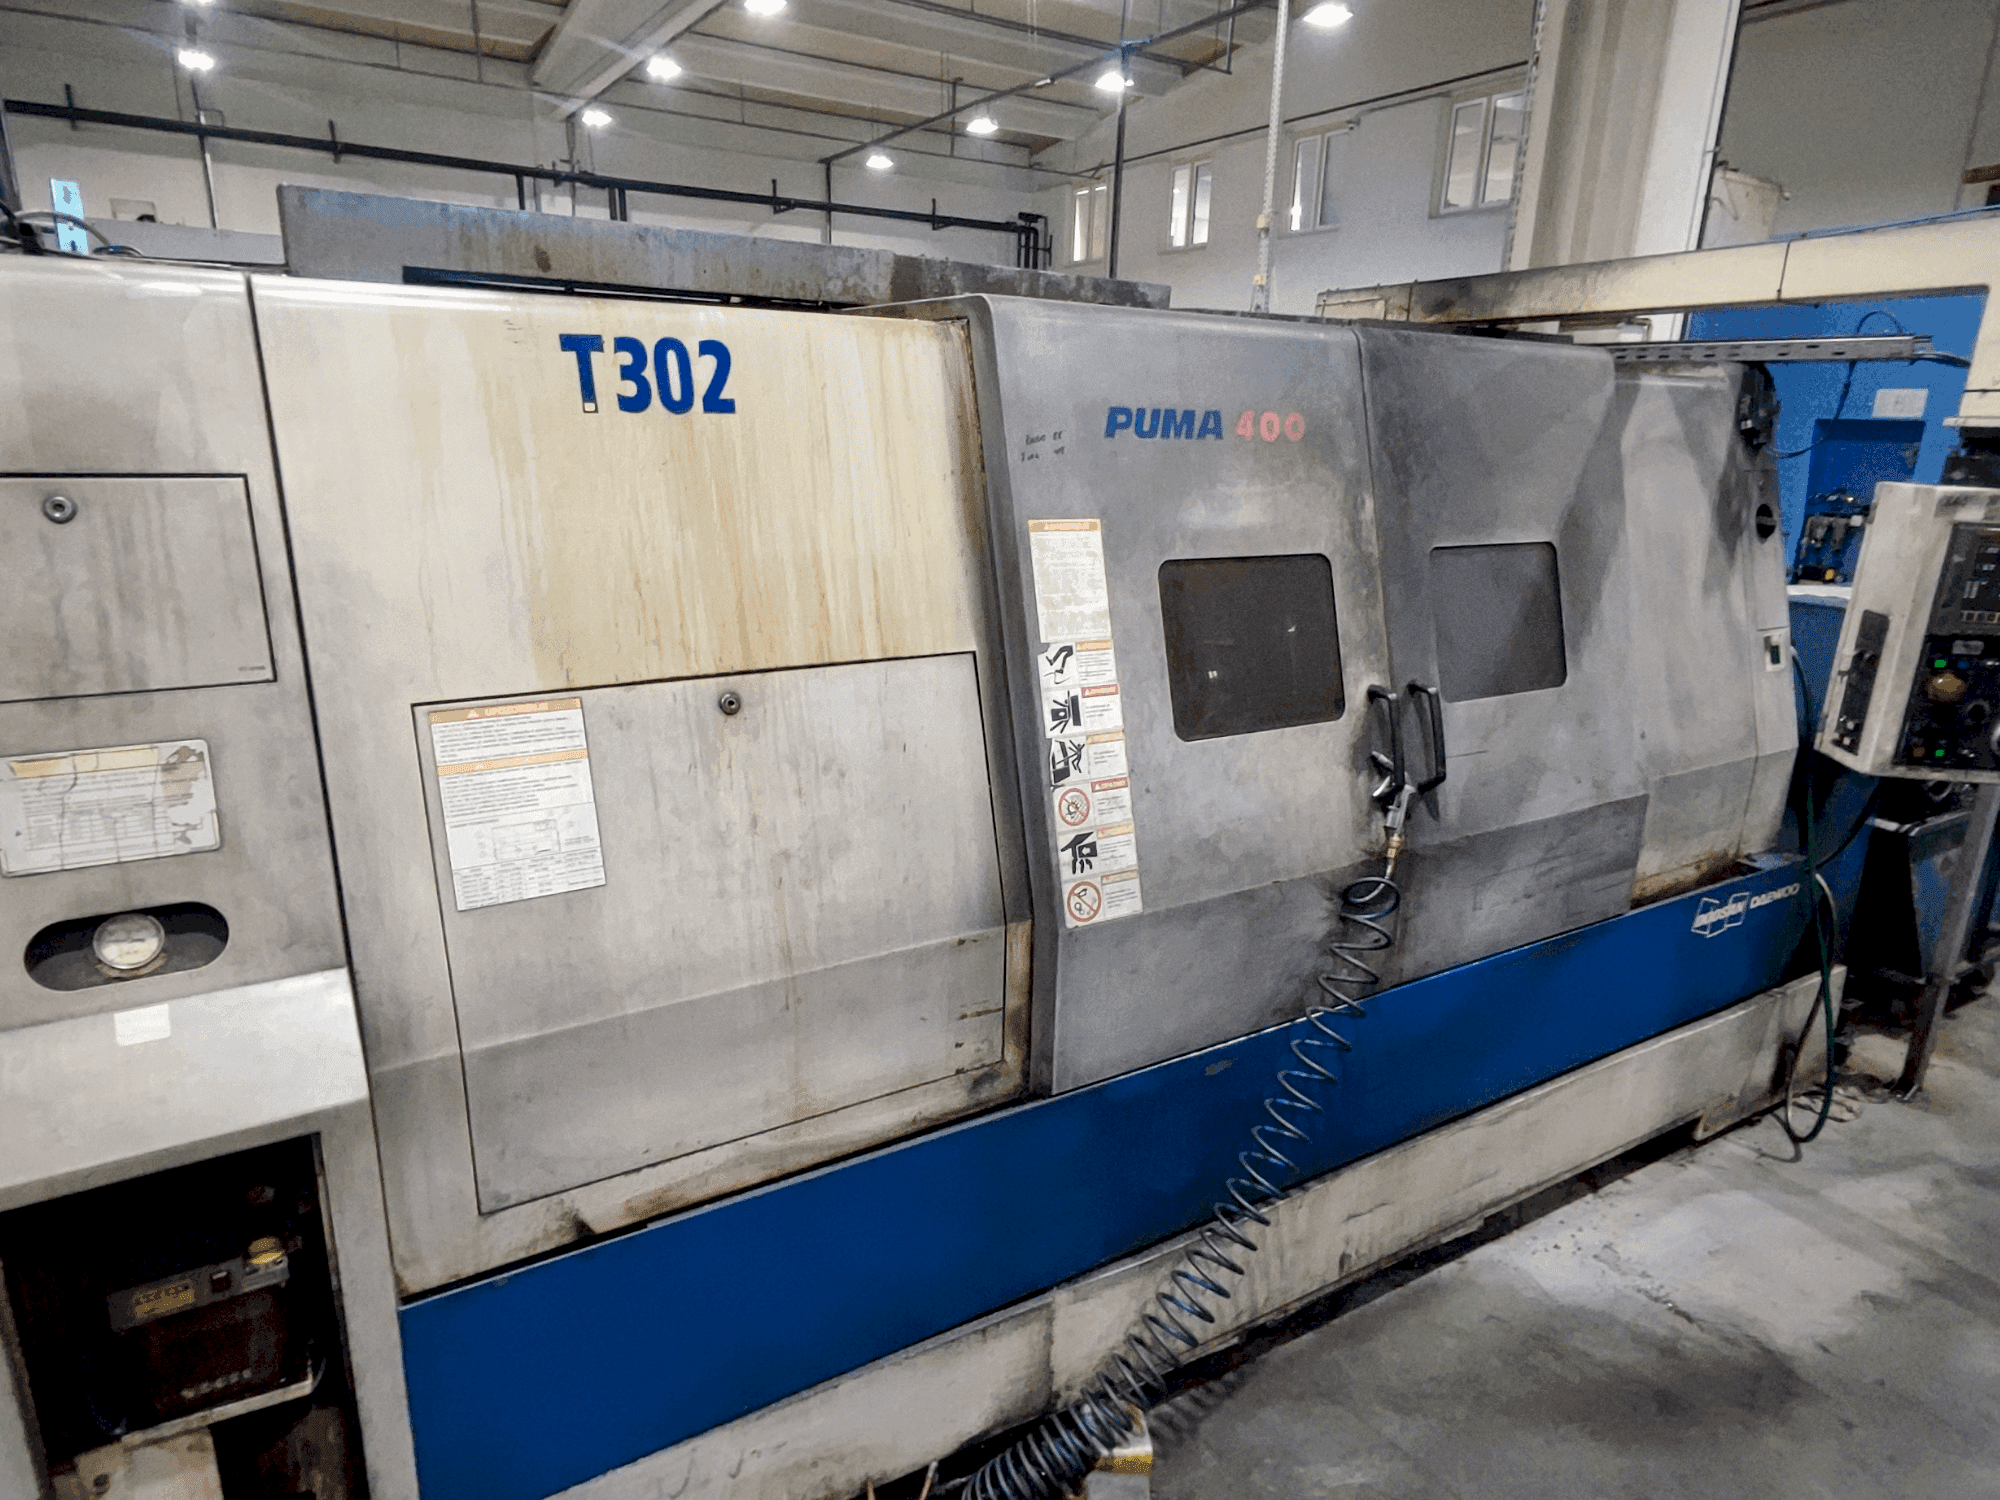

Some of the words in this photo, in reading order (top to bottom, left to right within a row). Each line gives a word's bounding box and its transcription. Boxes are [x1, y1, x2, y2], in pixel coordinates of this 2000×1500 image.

[559, 334, 735, 414] T302
[1104, 406, 1223, 440] PUMA
[1236, 410, 1304, 442] 400
